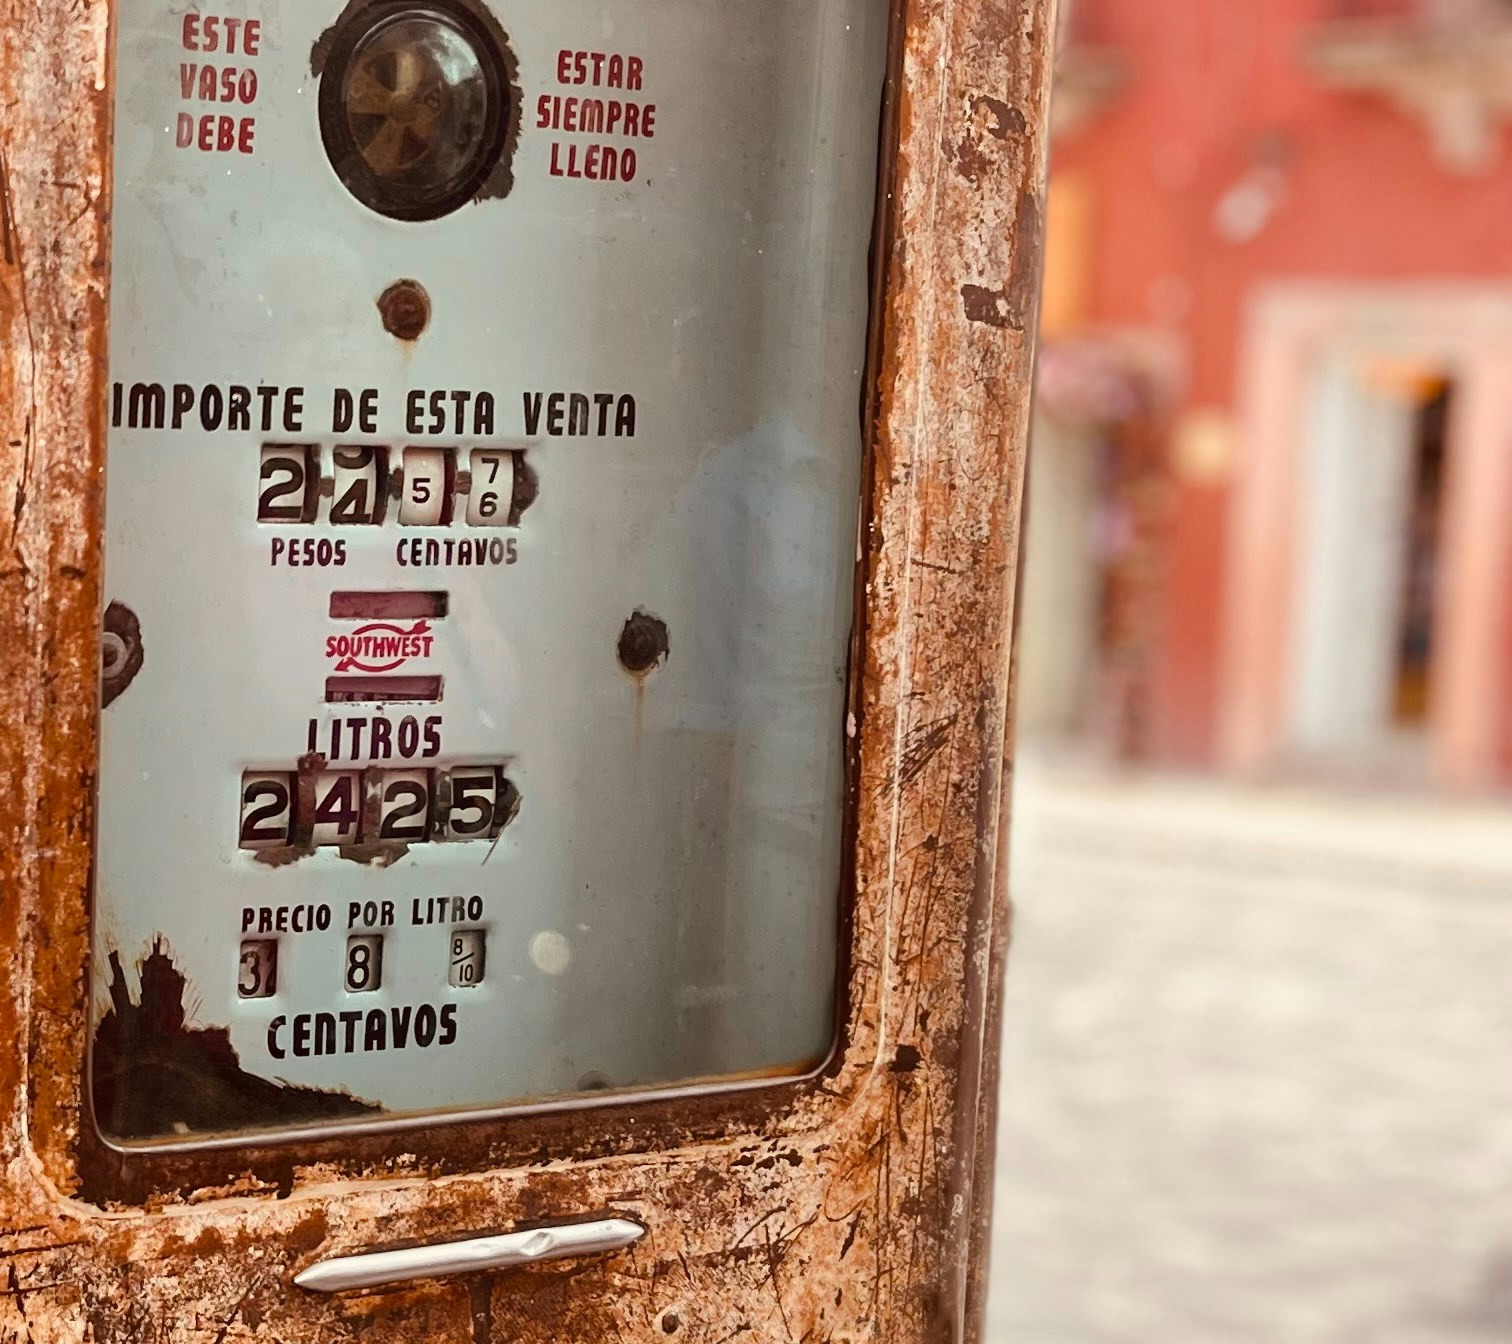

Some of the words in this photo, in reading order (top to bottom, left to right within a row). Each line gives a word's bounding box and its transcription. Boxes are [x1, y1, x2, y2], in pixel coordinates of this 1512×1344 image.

[182, 13, 262, 56] ESTE
[180, 64, 258, 105] VASO
[557, 49, 643, 91] ESTAR
[176, 113, 255, 154] DEBE
[537, 94, 656, 138] SIEMPRE
[549, 142, 637, 183] LLENO
[112, 382, 304, 433] IMPORTE
[333, 388, 378, 434] DE
[406, 389, 494, 435] ESTA
[524, 392, 637, 437] VENTA
[271, 537, 347, 566] PESOS
[396, 537, 518, 567] CENTAVOS
[325, 635, 434, 658] SOUTHWEST
[307, 716, 443, 760] LITROS
[241, 903, 331, 933] PRECIO
[348, 900, 395, 929] POR
[411, 895, 484, 926] LITRO
[267, 1003, 458, 1059] CENTAVOS
